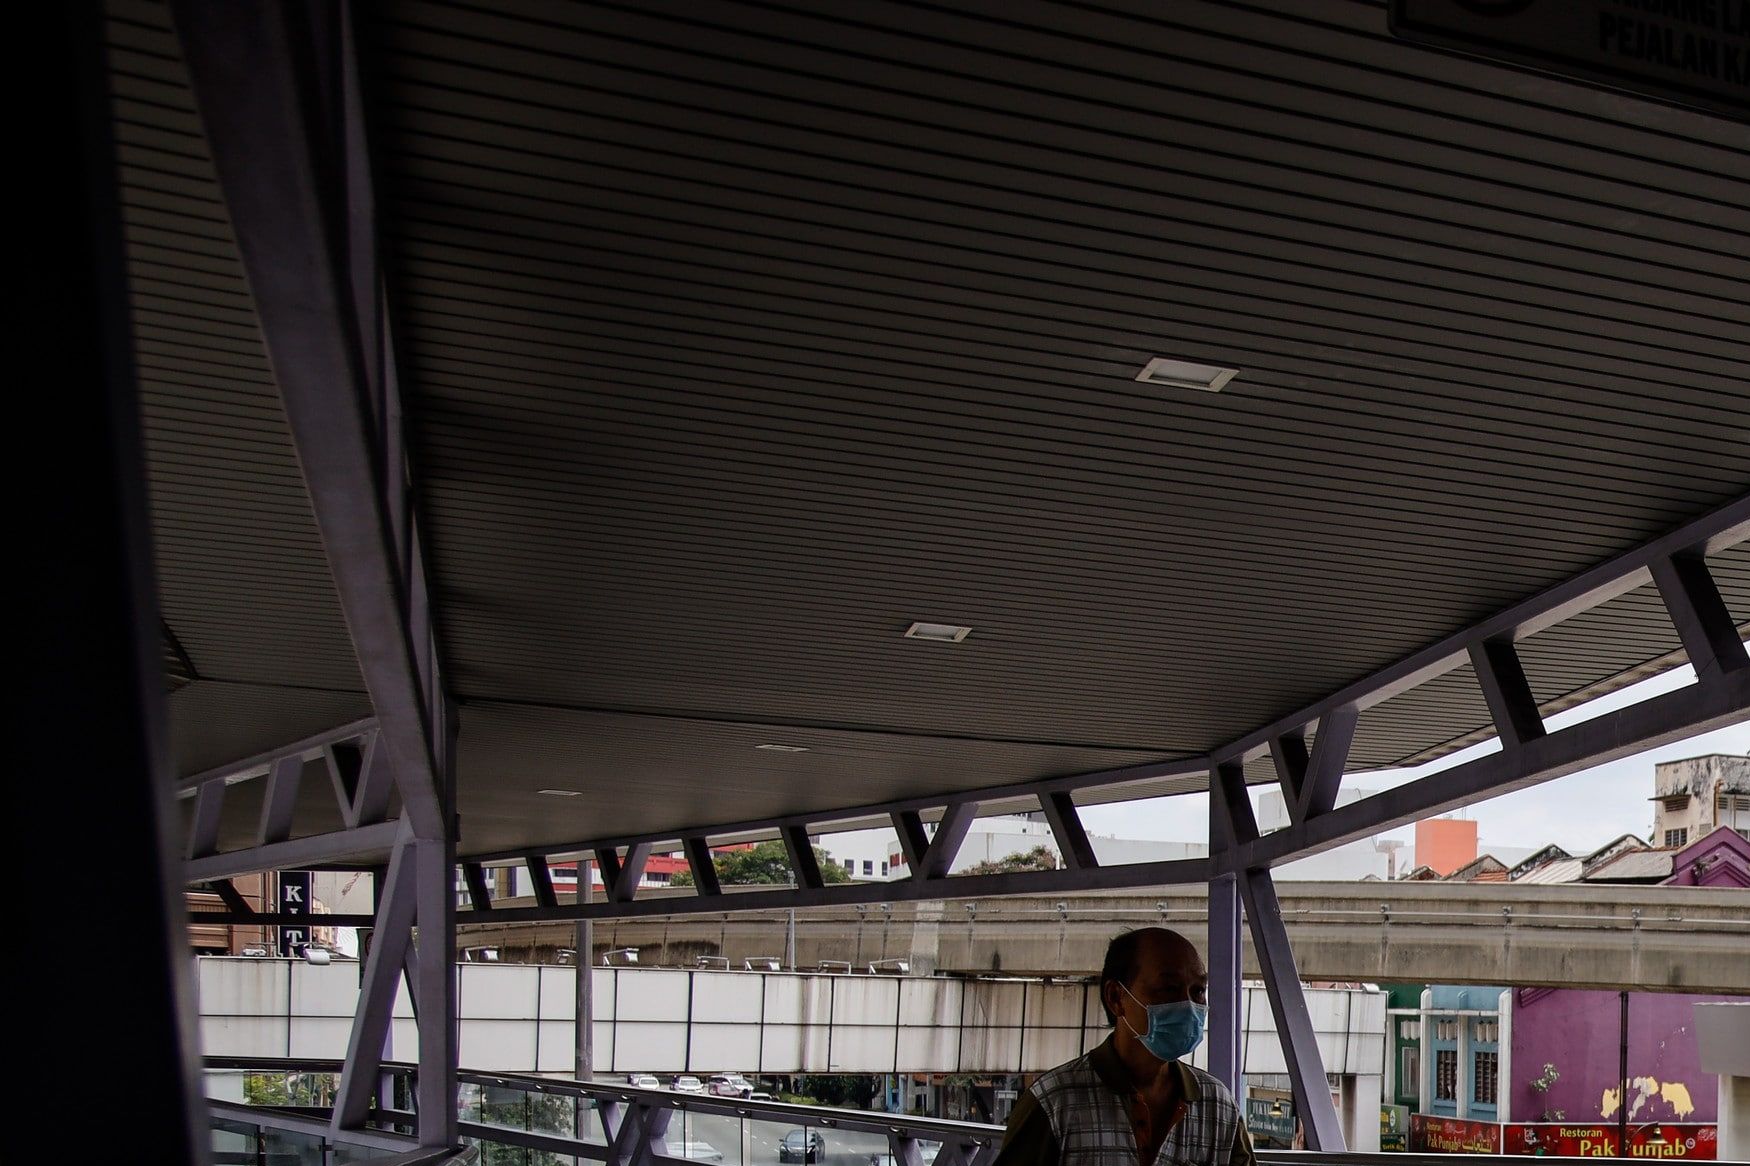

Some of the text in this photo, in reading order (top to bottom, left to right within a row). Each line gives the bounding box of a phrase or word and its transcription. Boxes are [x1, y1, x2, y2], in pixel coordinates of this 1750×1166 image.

[1599, 11, 1718, 79] PEJALAN
[1560, 1128, 1603, 1138] Restoran
[1580, 1138, 1686, 1159] Pak unjab
